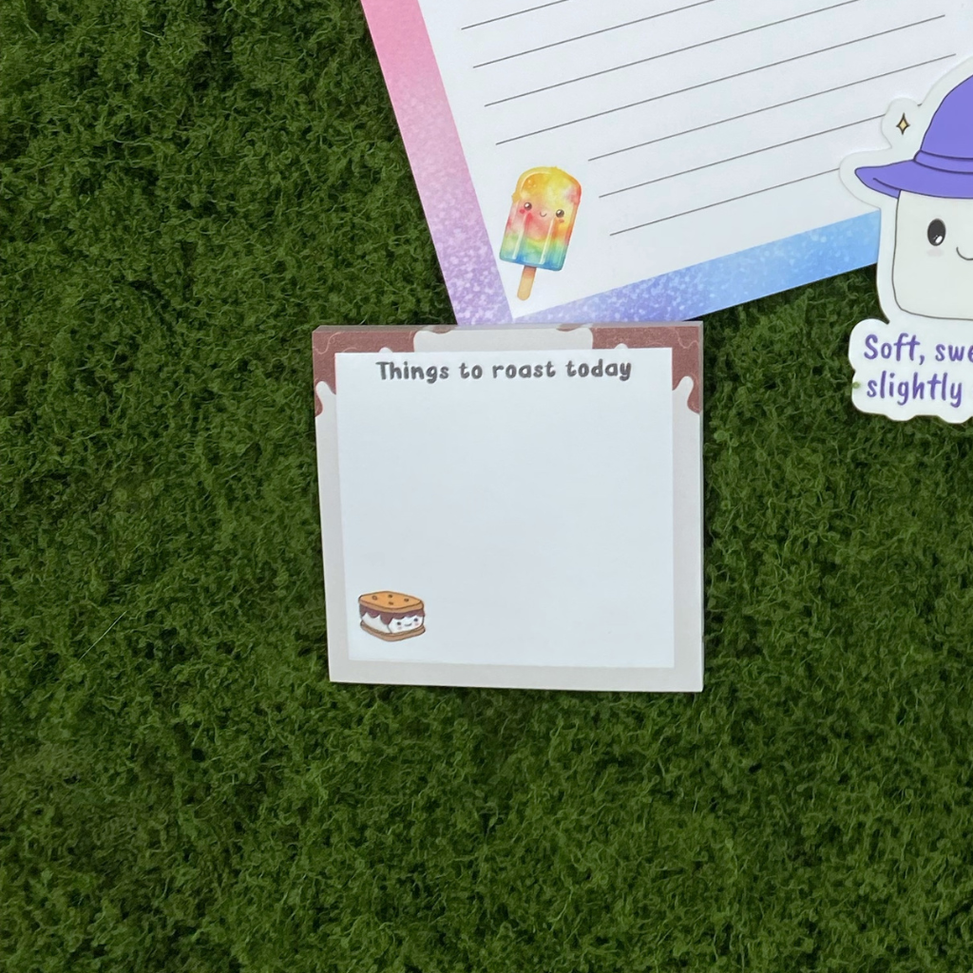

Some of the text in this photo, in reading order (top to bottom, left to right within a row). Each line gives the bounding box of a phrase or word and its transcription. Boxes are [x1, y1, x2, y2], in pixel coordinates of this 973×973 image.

[863, 332, 926, 366] Soft,
[375, 358, 633, 384] Things to roast today
[865, 370, 963, 408] slightly
